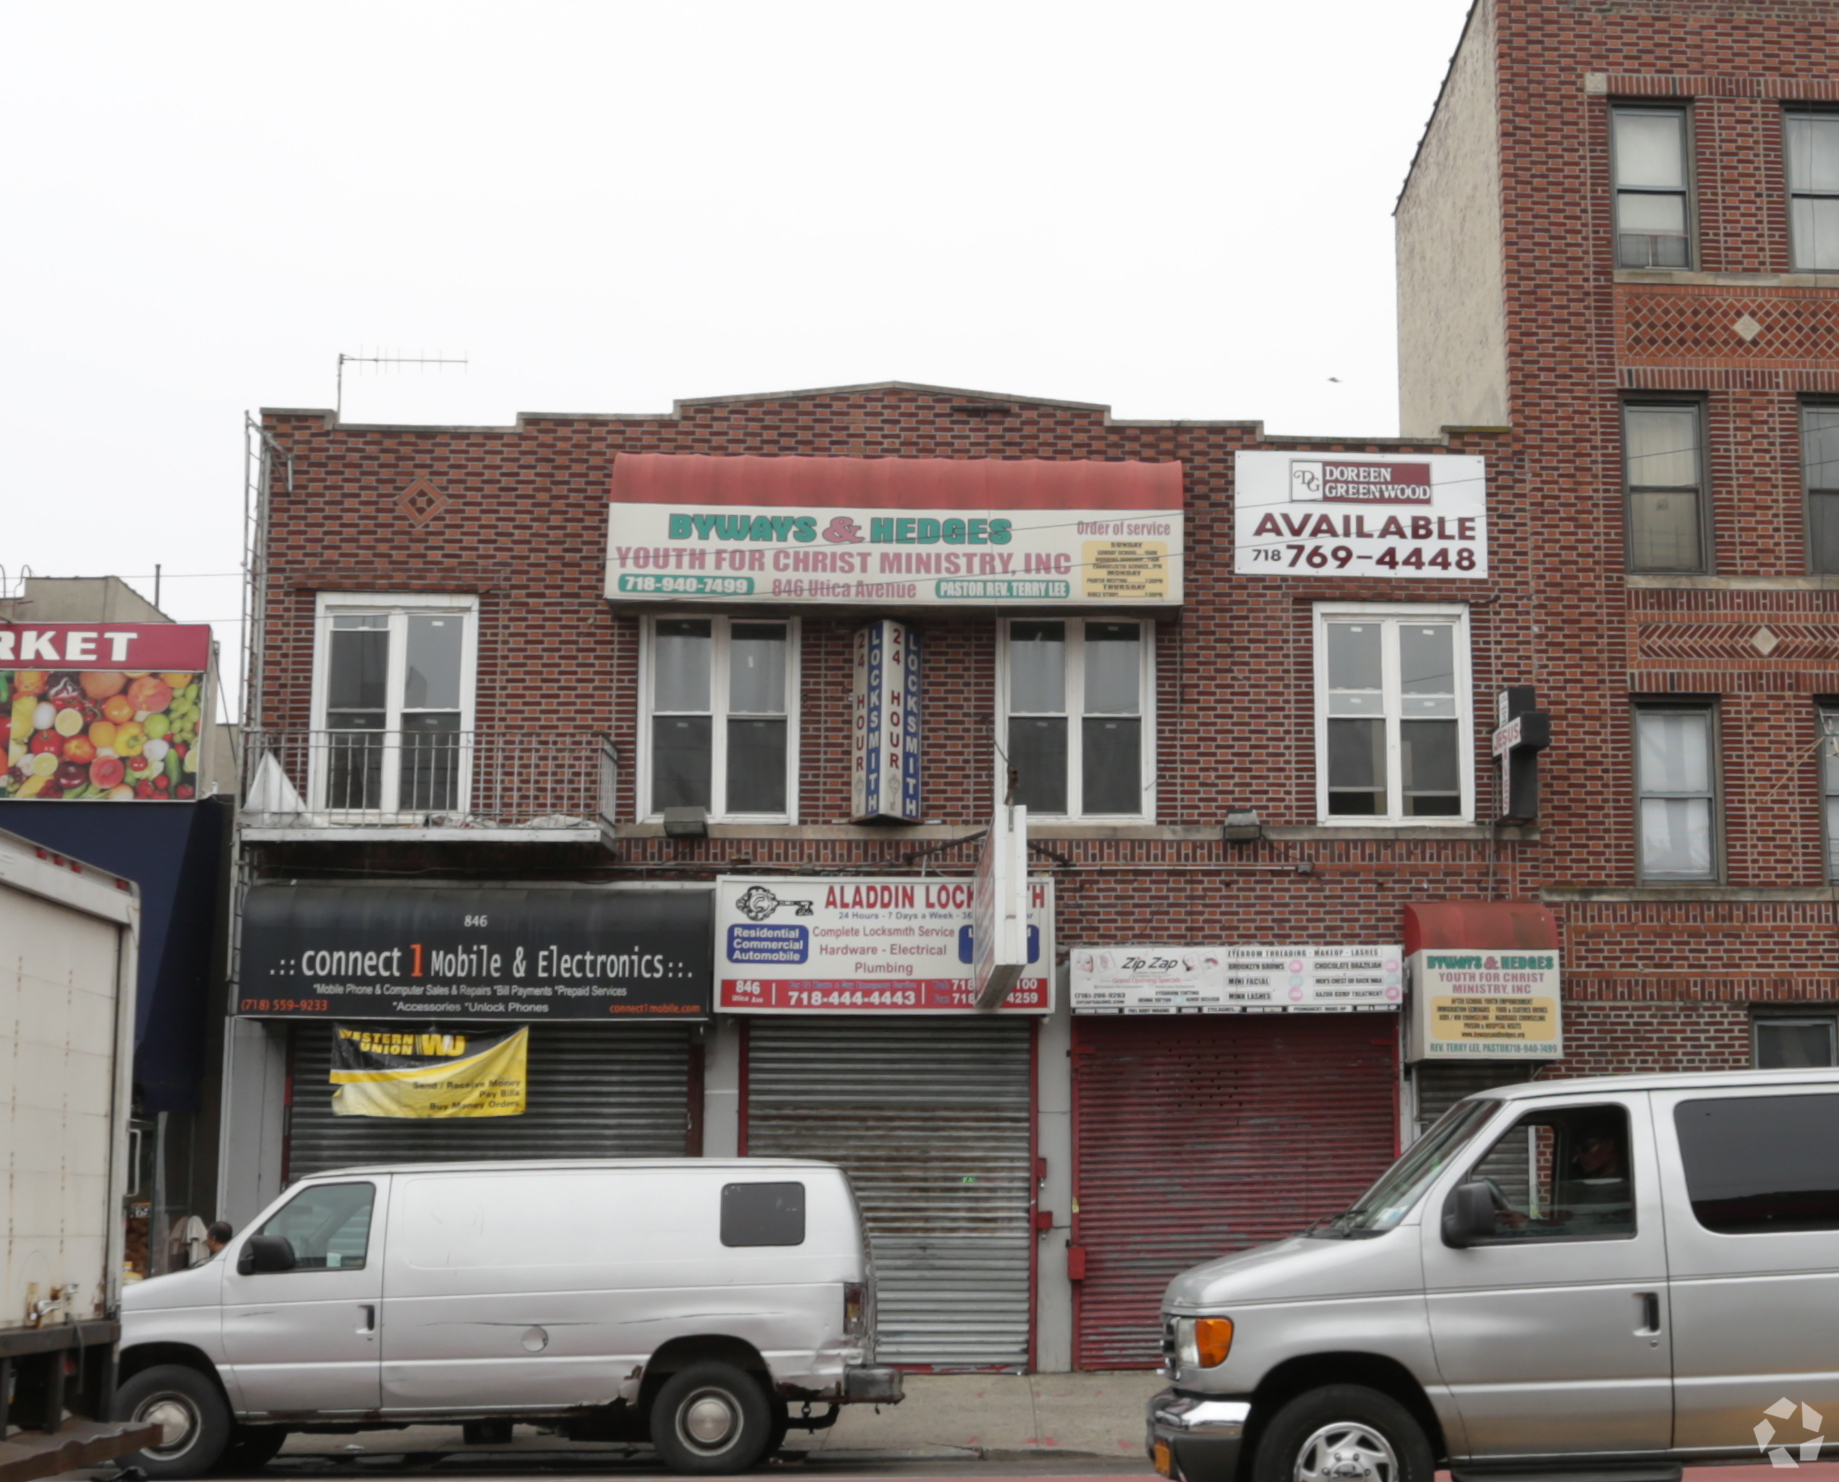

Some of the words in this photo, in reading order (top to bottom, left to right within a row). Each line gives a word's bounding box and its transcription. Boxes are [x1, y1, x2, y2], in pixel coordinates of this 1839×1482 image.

[1325, 466, 1392, 482] DOREEN
[1325, 482, 1430, 499] GREENWOOD
[668, 513, 817, 542] BYWAYS
[822, 516, 865, 543] &
[870, 517, 1012, 544] HEDGES
[1077, 521, 1110, 536] Order
[1113, 521, 1124, 536] of
[1126, 522, 1171, 536] service
[1252, 513, 1476, 540] AVAILABLE
[616, 546, 706, 570] YOUTH
[714, 549, 765, 572] FOR
[773, 550, 872, 574] CHRIST
[880, 552, 1016, 577] MINISTRY,
[1024, 553, 1072, 576] INC
[1252, 549, 1281, 562] 718
[1286, 544, 1476, 571] 769-4448
[625, 576, 748, 594] 718-940-7499
[772, 579, 804, 597] 846
[808, 580, 851, 598] Utica
[855, 580, 916, 598] Avenue
[940, 582, 984, 597] PASTOR
[986, 582, 1010, 597] REV.
[1011, 582, 1046, 597] TERRY
[1048, 582, 1066, 597] LEE
[868, 629, 880, 812] LOCKSMITH
[906, 634, 918, 816] LOCKSMITH
[856, 694, 865, 772] HOUR
[890, 690, 901, 770] HOUR
[1494, 722, 1519, 750] JESUS
[824, 884, 914, 909] ALADDIN
[464, 915, 488, 927] 846
[839, 912, 848, 920] 24
[852, 912, 878, 920] Hours
[888, 912, 892, 920] 7
[896, 912, 918, 921] Days
[930, 912, 953, 920] Week
[734, 927, 800, 938] Residential
[812, 926, 860, 940] Complete
[863, 926, 914, 937] Locksmith
[918, 926, 954, 937] Service
[733, 938, 804, 950] Commercial
[820, 944, 878, 956] Hardware
[890, 944, 946, 956] Electrical
[302, 948, 401, 976] connect
[410, 944, 424, 976] 1
[431, 945, 502, 977] Mobile
[512, 946, 526, 978] &
[538, 946, 664, 978] Electronics
[732, 950, 800, 961] Automobile
[1426, 955, 1482, 969] BYWAYS
[1484, 956, 1499, 970] &
[1500, 956, 1554, 970] HEDGES
[855, 962, 914, 976] Plumbing
[1121, 956, 1146, 972] Zip
[1148, 956, 1178, 972] Zap
[1438, 972, 1476, 982] YOUTH
[1480, 972, 1500, 982] FOR
[1503, 972, 1544, 982] CHRIST
[346, 984, 373, 994] Phone
[374, 984, 381, 994] &
[383, 984, 424, 996] Computer
[426, 985, 449, 995] Sales
[451, 985, 458, 995] &
[460, 985, 491, 997] Repairs
[512, 986, 552, 998] Payments
[592, 986, 627, 996] Services
[736, 980, 760, 995] 846
[1452, 984, 1509, 994] MINISTRY,
[1512, 984, 1531, 994] INC
[240, 999, 269, 1011] (718)
[273, 999, 328, 1011] 559-9233
[788, 990, 916, 1006] 718-444-4443
[508, 1002, 548, 1012] Phones
[339, 1029, 414, 1044] WESTERN
[360, 1042, 413, 1055] UNION
[1446, 1044, 1467, 1052] TERRY
[446, 1081, 484, 1089] Receive
[430, 1102, 448, 1110] Buy
